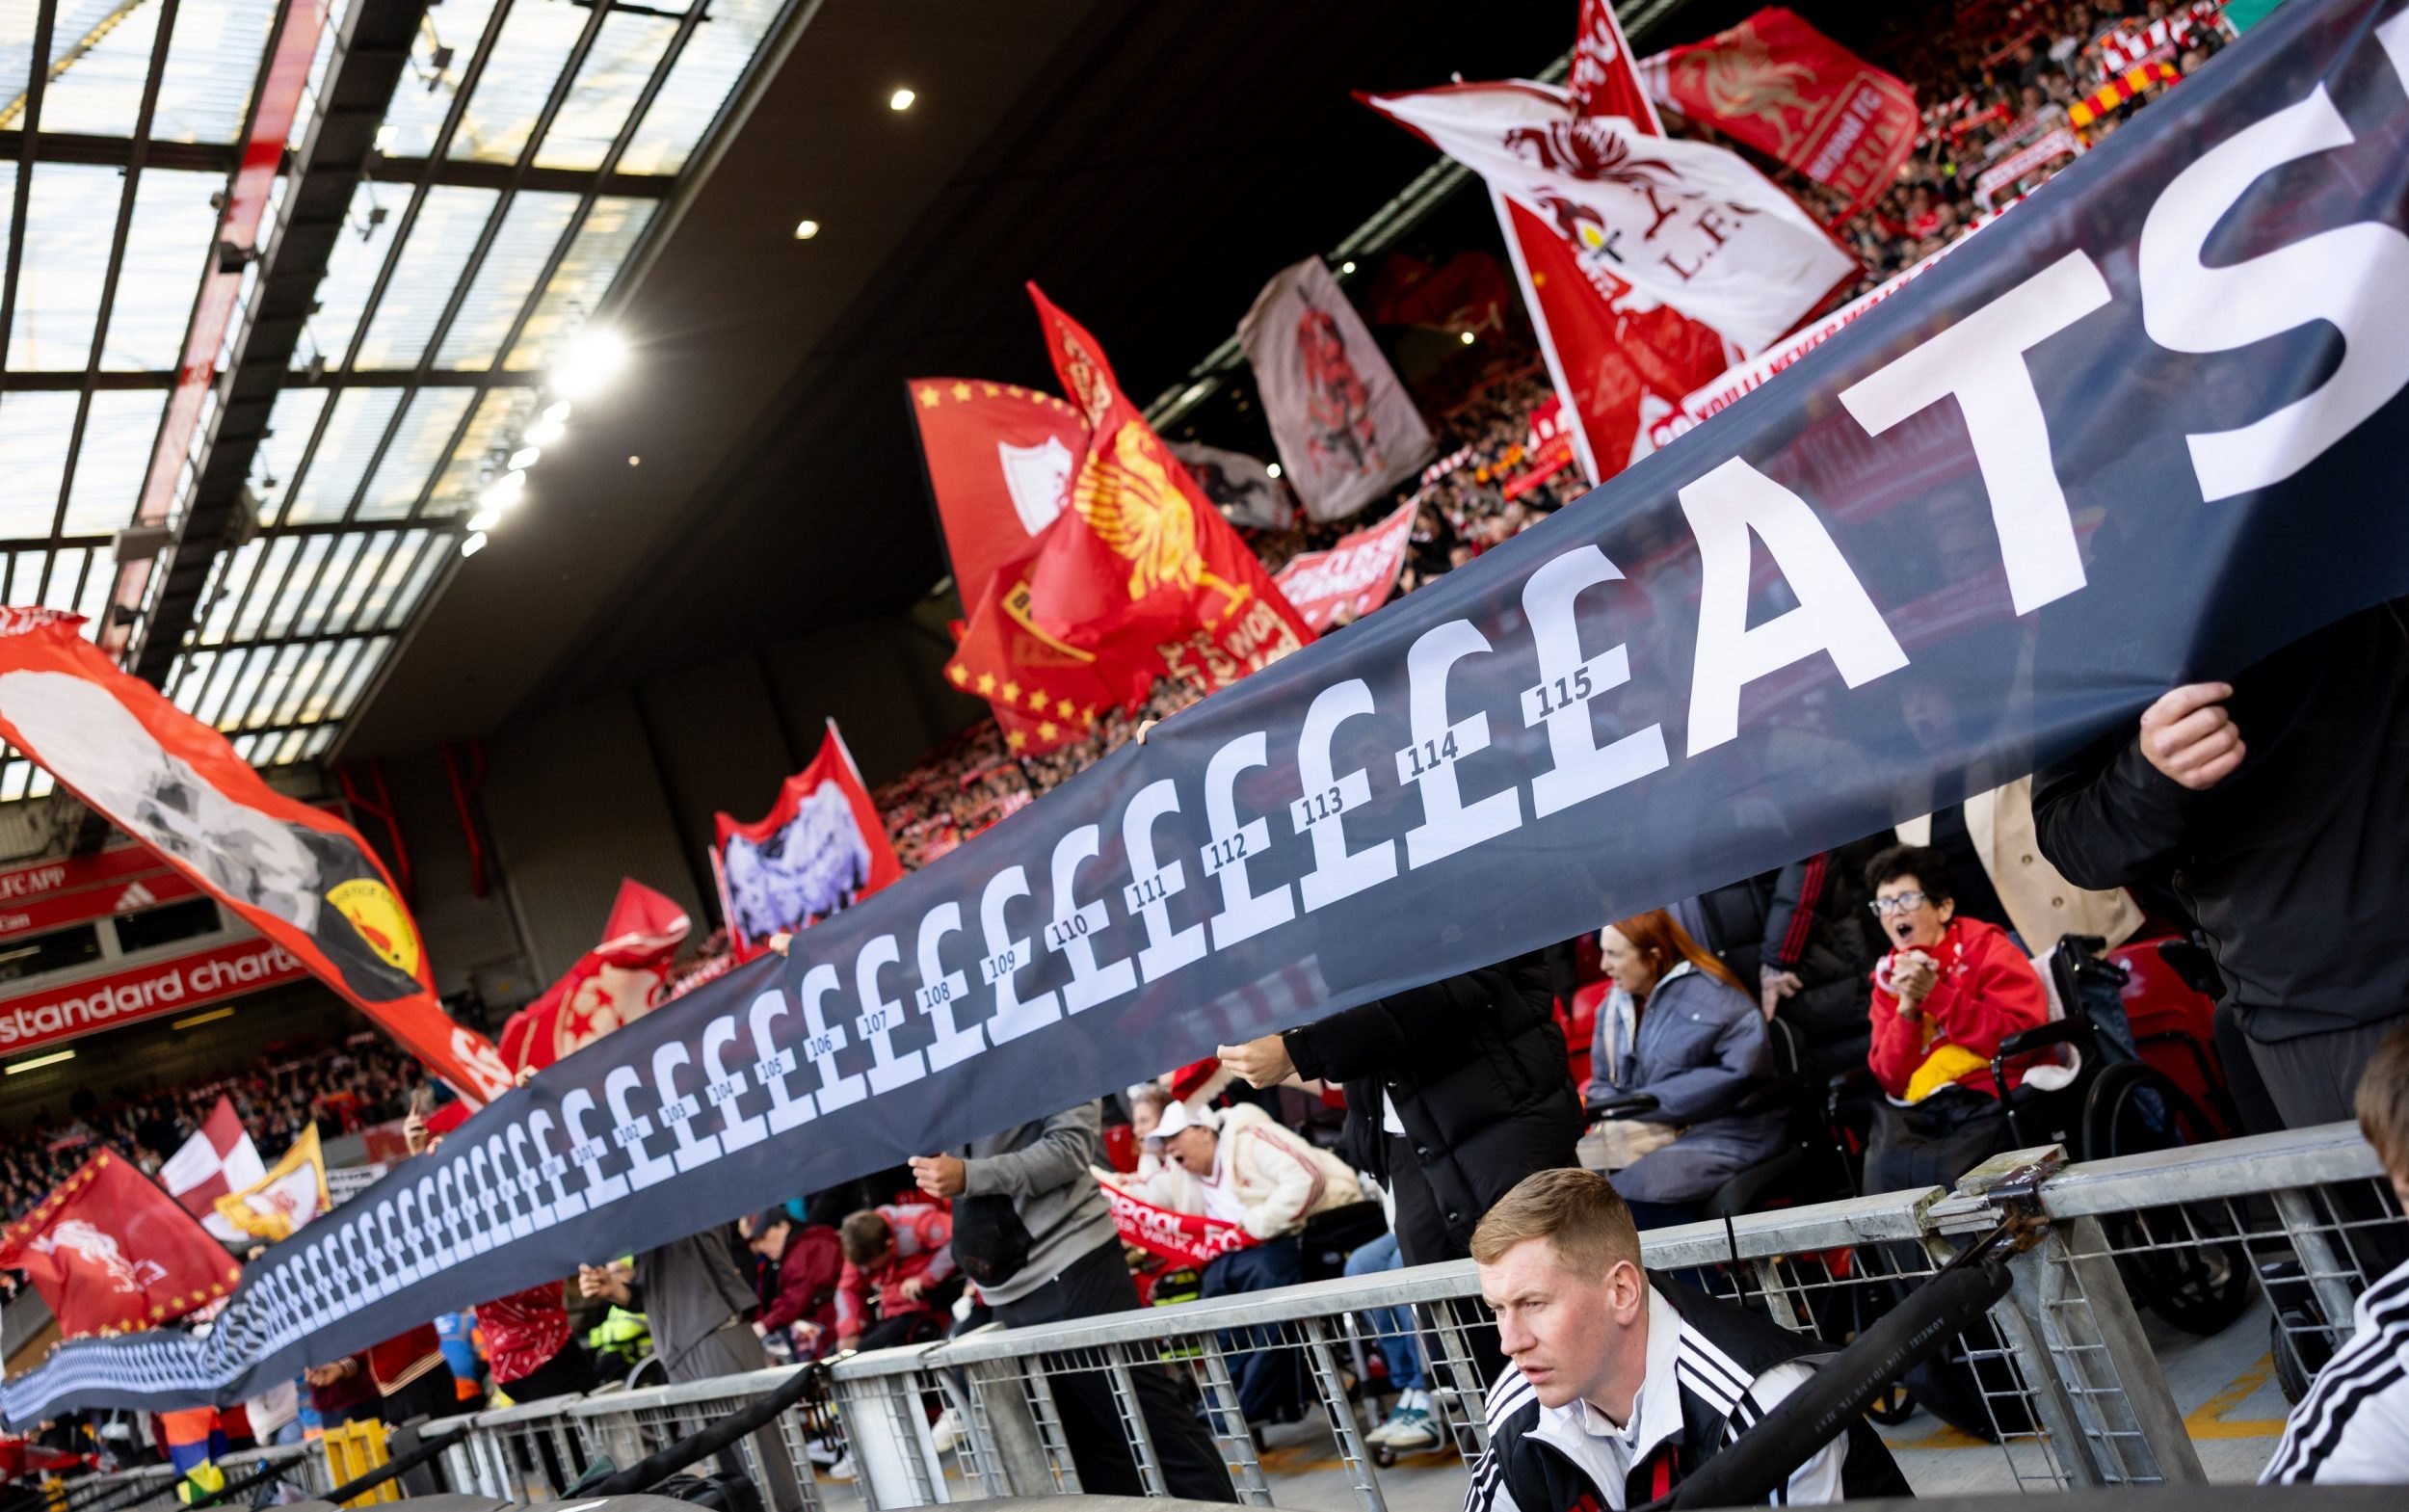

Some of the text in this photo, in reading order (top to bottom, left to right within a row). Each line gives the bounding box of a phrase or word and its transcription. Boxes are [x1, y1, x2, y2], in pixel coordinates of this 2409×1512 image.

[0, 969, 184, 1044] standard
[665, 1102, 687, 1123] 103
[712, 1080, 733, 1101] 104
[761, 1057, 782, 1079] 105
[810, 1033, 833, 1057] 106
[862, 1009, 888, 1036] 107
[922, 981, 951, 1009] 108
[988, 950, 1017, 980] 109
[1051, 915, 1089, 949] 110
[1132, 875, 1168, 910] 111
[1210, 833, 1248, 871] 112
[1302, 786, 1344, 826] 113
[1408, 729, 1458, 777] 114
[1536, 666, 1592, 718] 115
